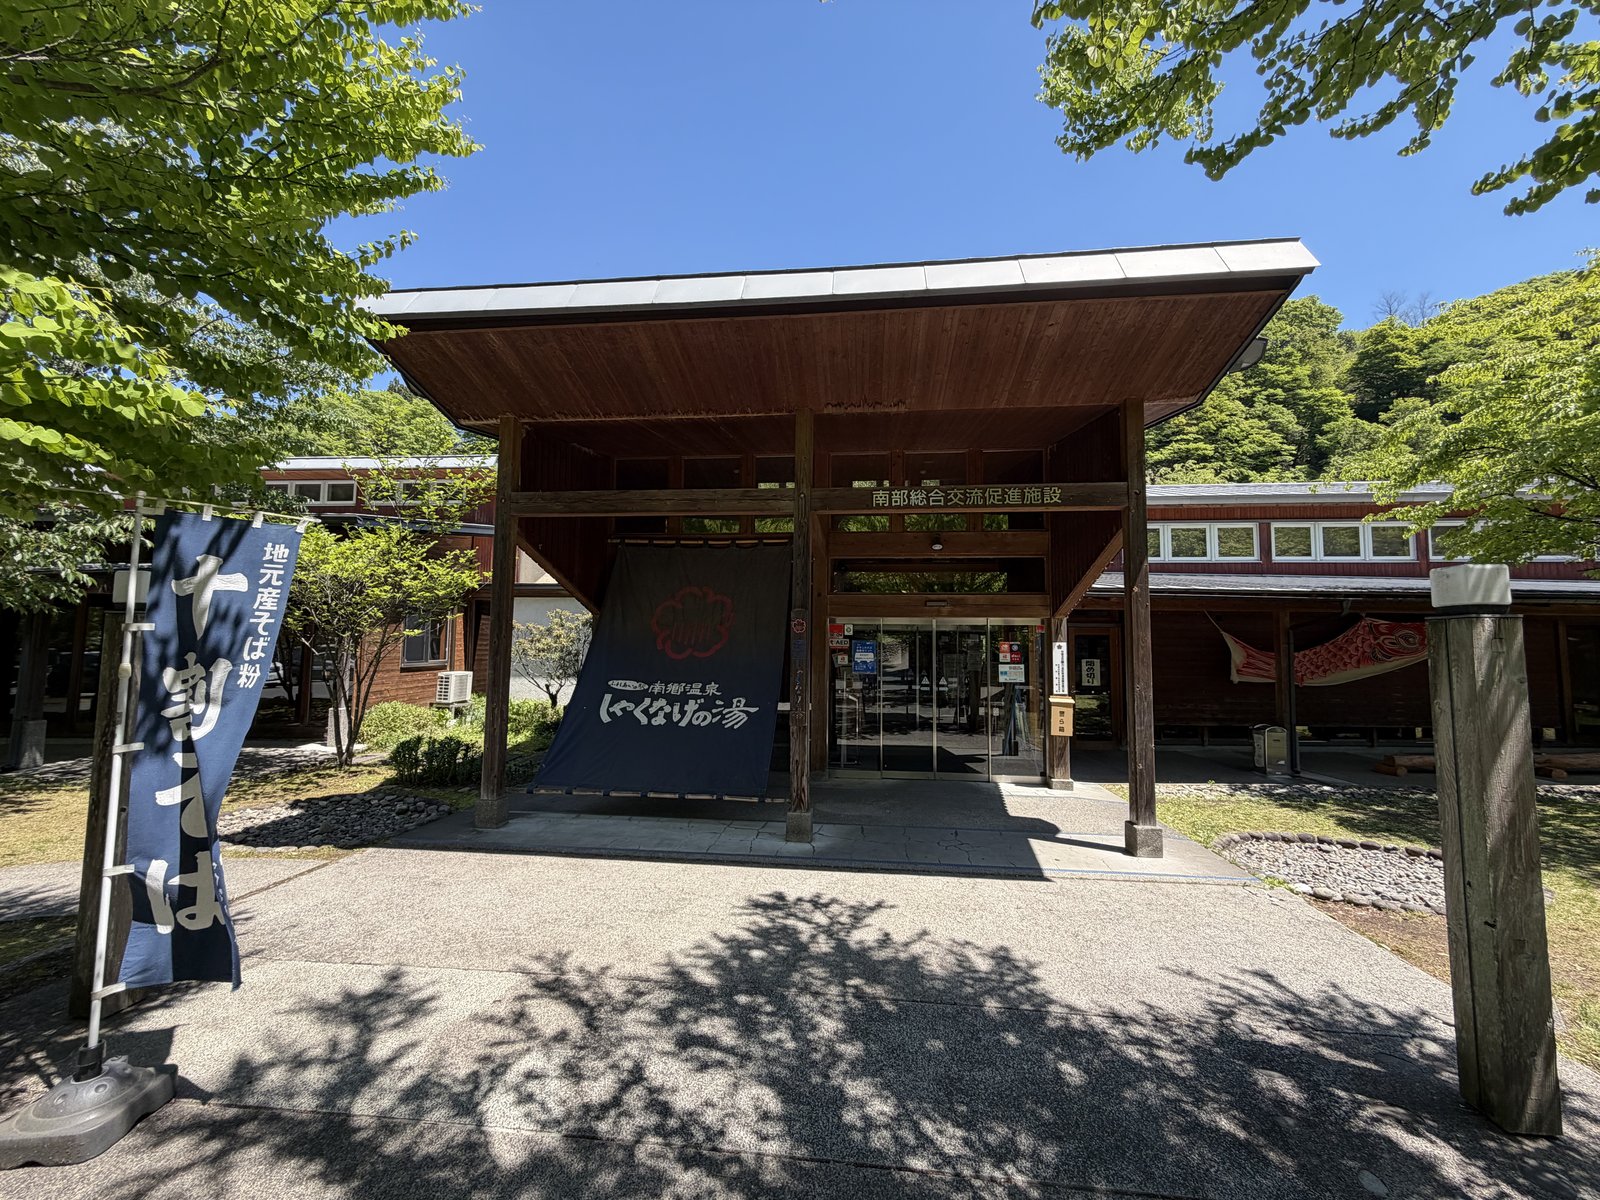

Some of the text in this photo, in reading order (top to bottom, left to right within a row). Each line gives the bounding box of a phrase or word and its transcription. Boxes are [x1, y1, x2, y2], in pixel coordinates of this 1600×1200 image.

[872, 486, 1062, 507] 南部総合交流促進施設
[237, 542, 289, 689] 地元産そば粉
[648, 680, 722, 696] 南郷温泉
[599, 694, 759, 729] しゃくなげの湯
